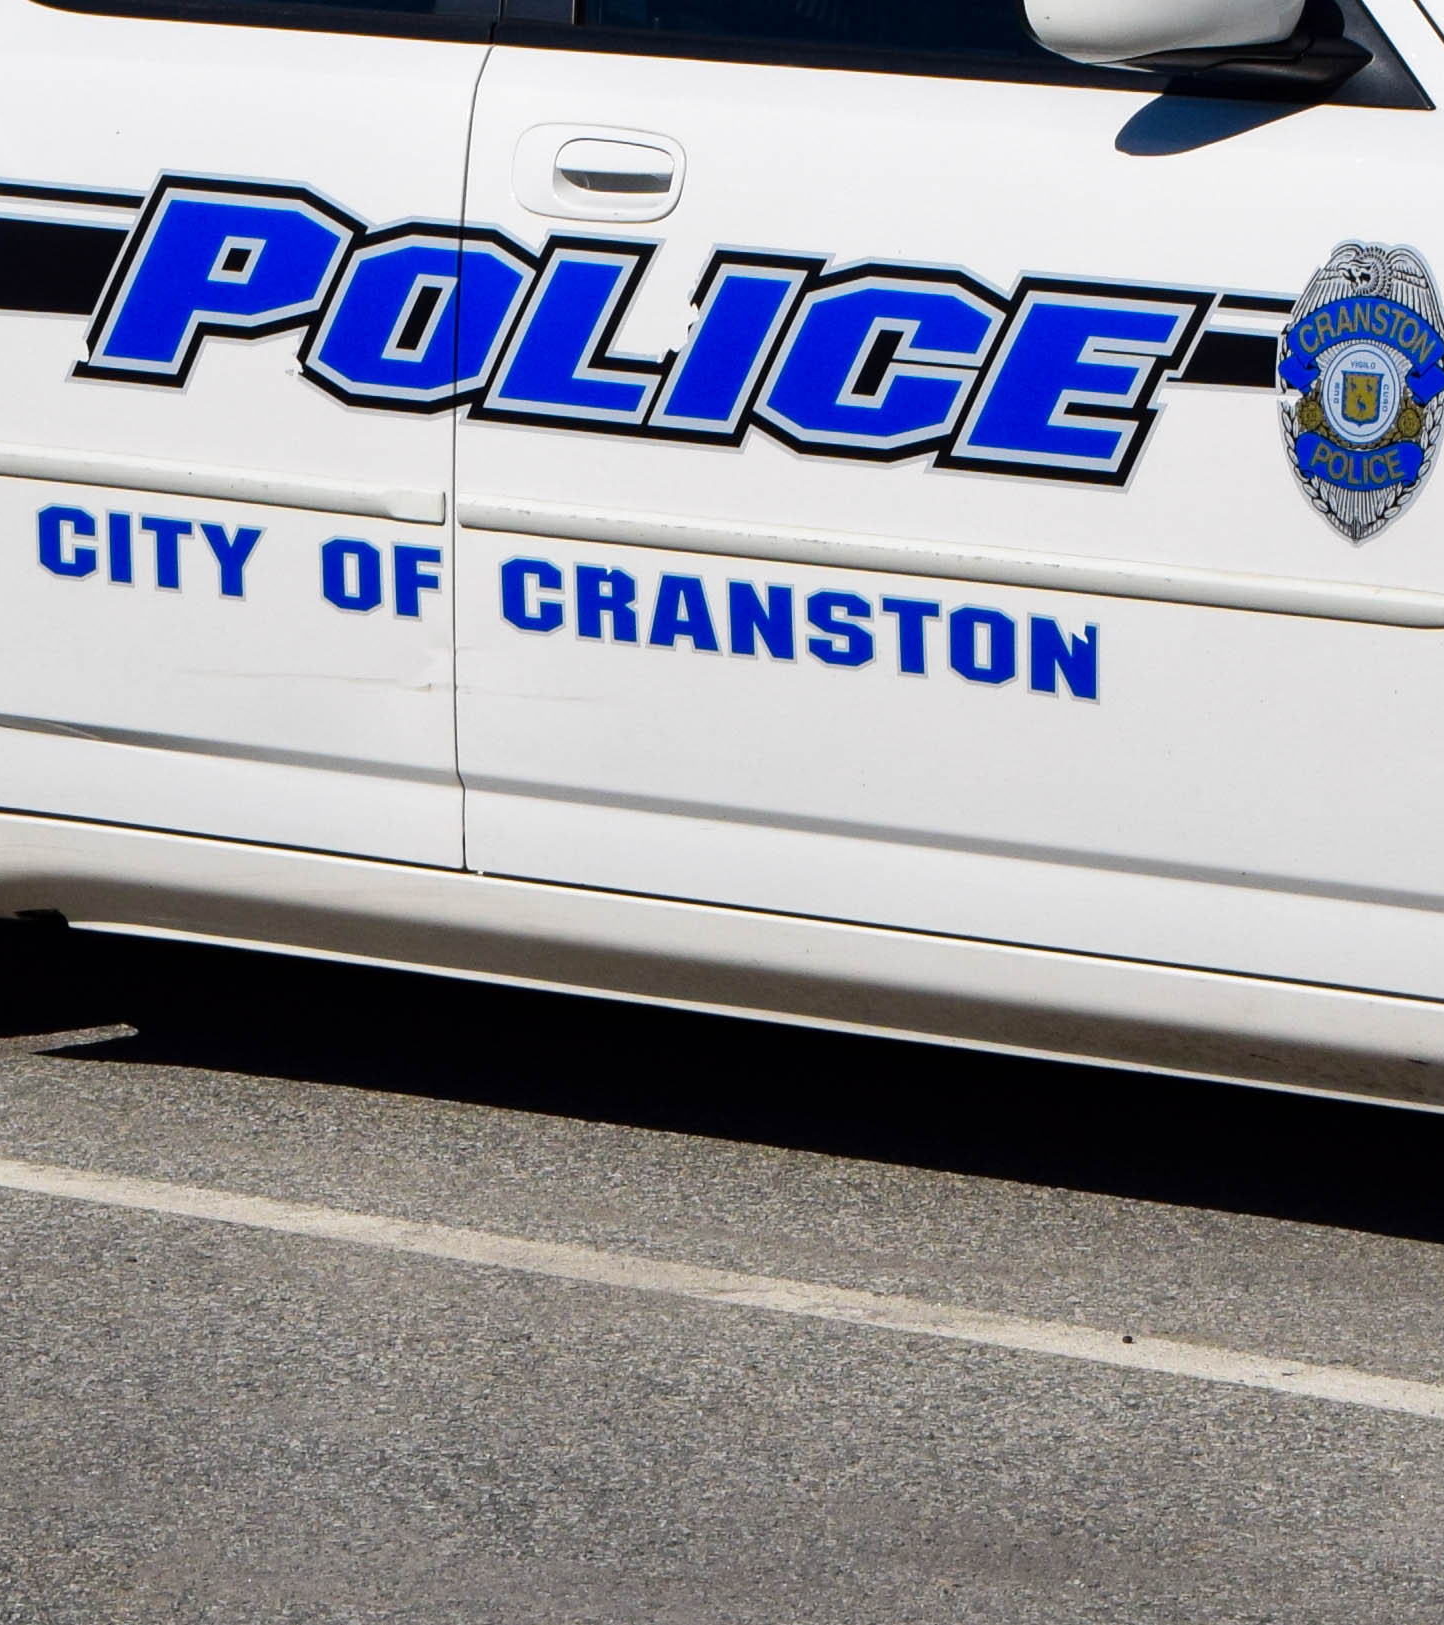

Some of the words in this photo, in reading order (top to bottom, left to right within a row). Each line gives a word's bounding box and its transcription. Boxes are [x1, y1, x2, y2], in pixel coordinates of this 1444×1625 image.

[74, 176, 1212, 486] POLICE
[1299, 303, 1436, 364] CRANSTON
[1311, 442, 1404, 486] POLICE
[36, 503, 262, 598] CITY
[319, 535, 444, 618] OF
[499, 556, 1100, 701] CRANSTON
